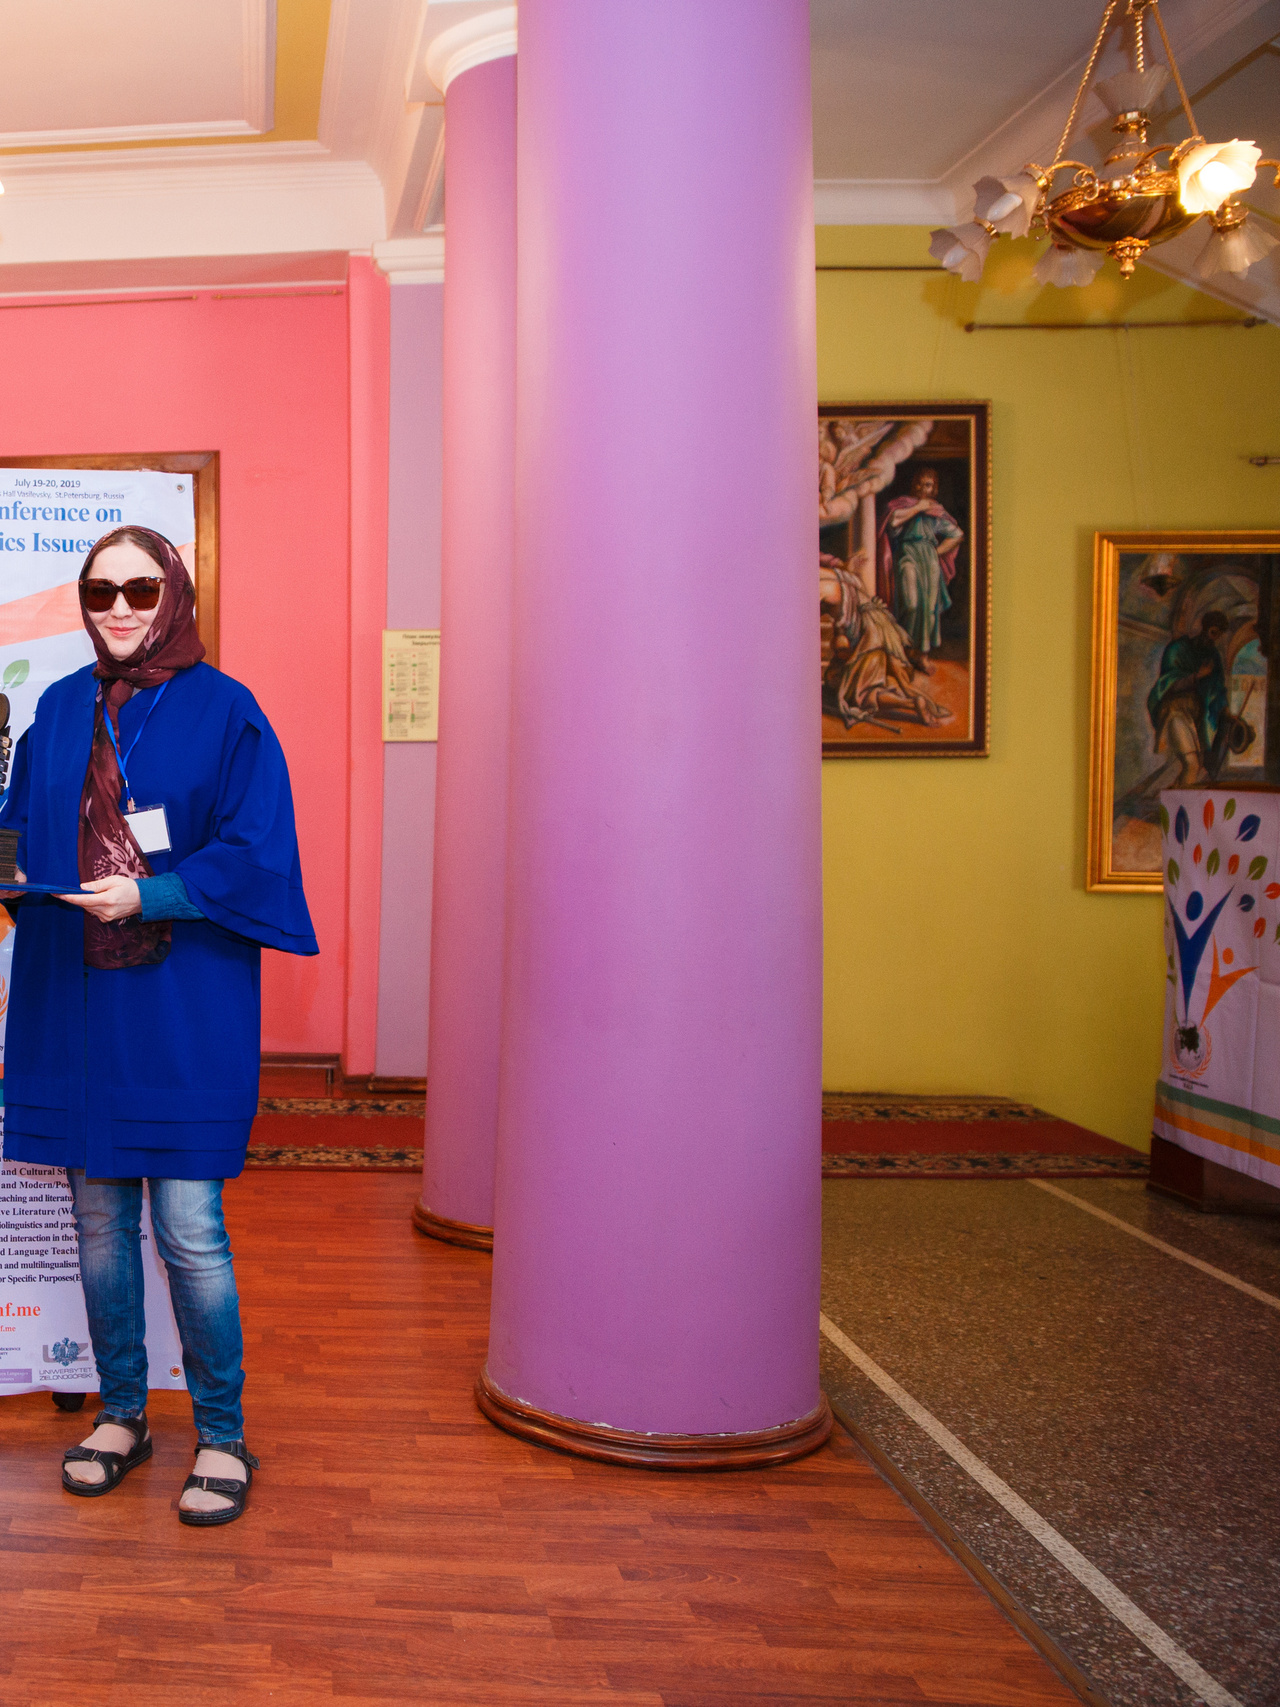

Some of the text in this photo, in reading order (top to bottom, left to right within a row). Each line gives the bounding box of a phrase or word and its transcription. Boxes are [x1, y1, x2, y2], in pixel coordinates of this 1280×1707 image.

[14, 479, 81, 488] July 19-20, 2019
[95, 508, 123, 523] on
[32, 532, 96, 553] Issues
[2, 1168, 17, 1176] and
[20, 1168, 55, 1176] Cultural
[28, 1194, 44, 1202] and
[12, 1208, 56, 1216] Literature
[10, 1234, 51, 1242] interaction
[52, 1234, 60, 1242] in
[62, 1234, 73, 1242] the
[8, 1248, 49, 1258] Language
[4, 1262, 19, 1270] and
[20, 1262, 80, 1271] multilingualism
[7, 1276, 38, 1284] Specific
[39, 1367, 92, 1375] UNIWERSYTET
